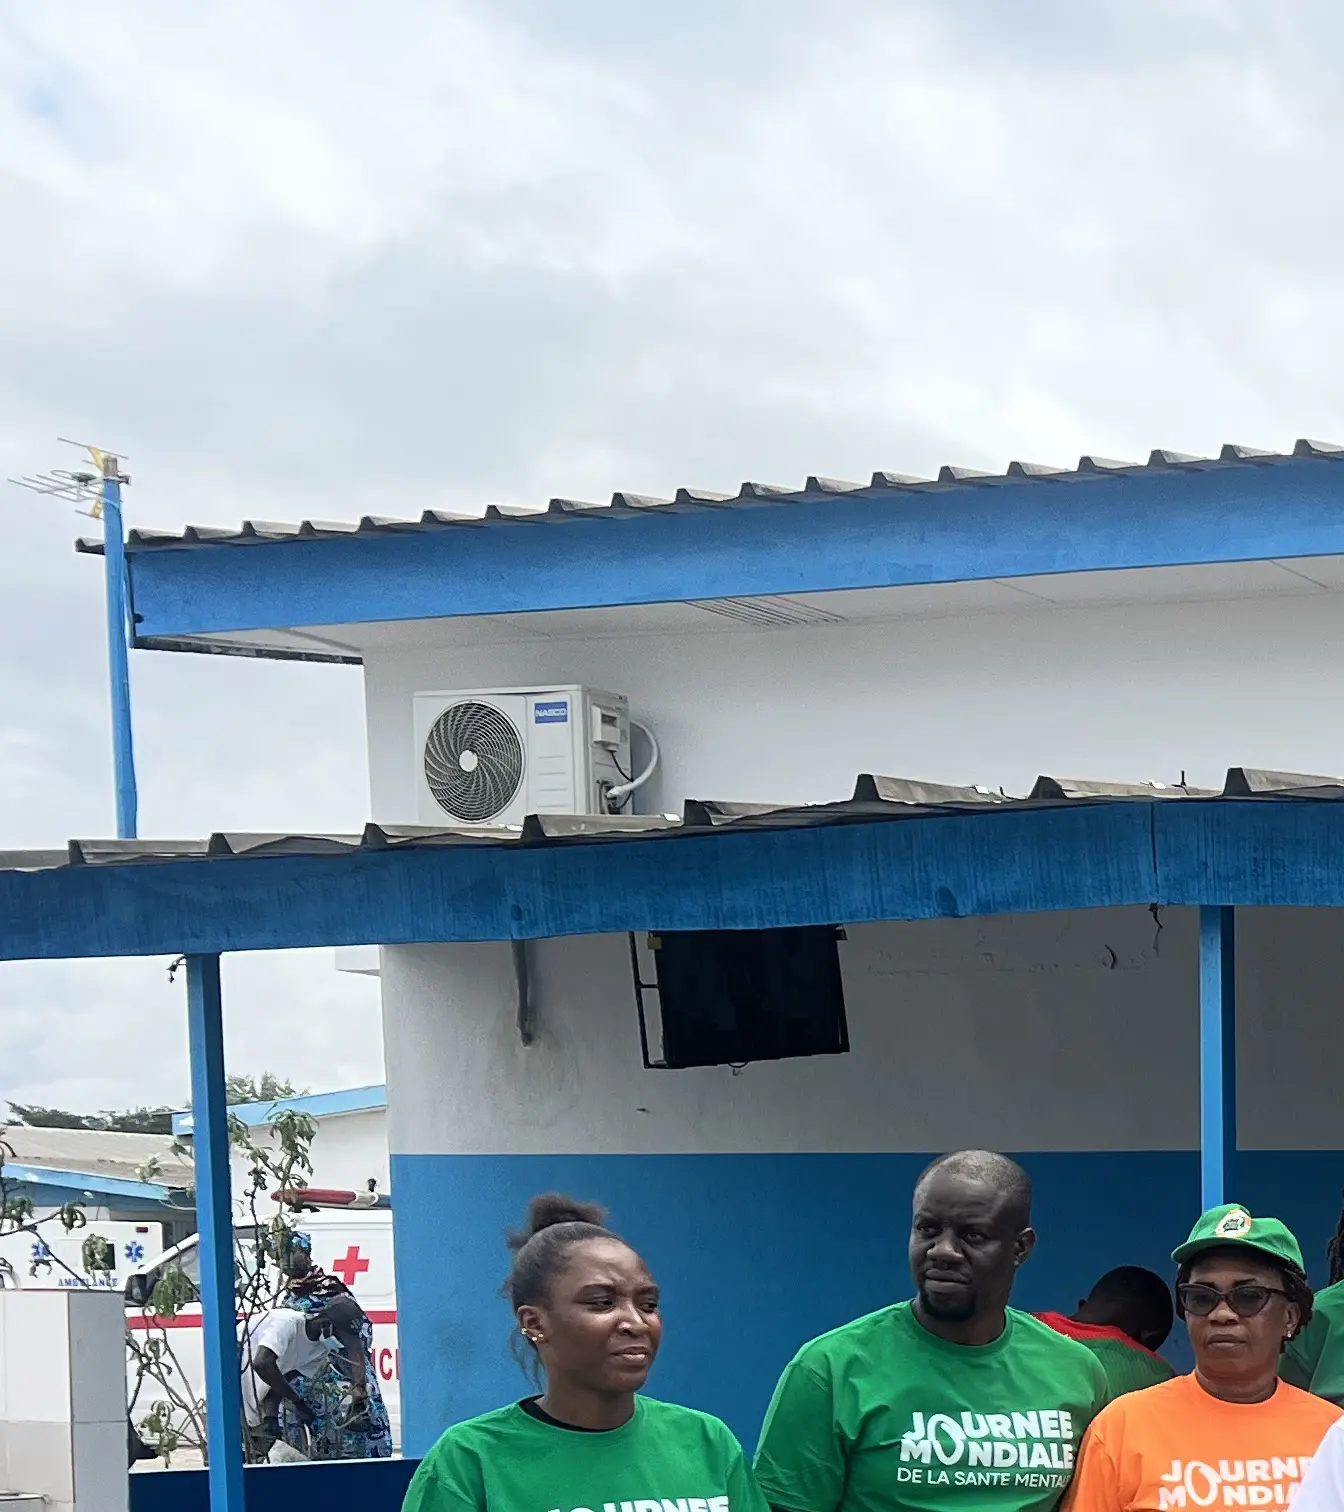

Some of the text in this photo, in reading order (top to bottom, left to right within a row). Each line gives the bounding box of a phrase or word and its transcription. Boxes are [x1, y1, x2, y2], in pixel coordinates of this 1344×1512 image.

[536, 708, 566, 717] NASCO
[902, 1410, 1074, 1441] JOURNEE
[899, 1438, 1075, 1469] MONDIALE
[896, 1467, 923, 1484] DE
[927, 1470, 950, 1485] LA
[954, 1471, 1010, 1487] SANTE
